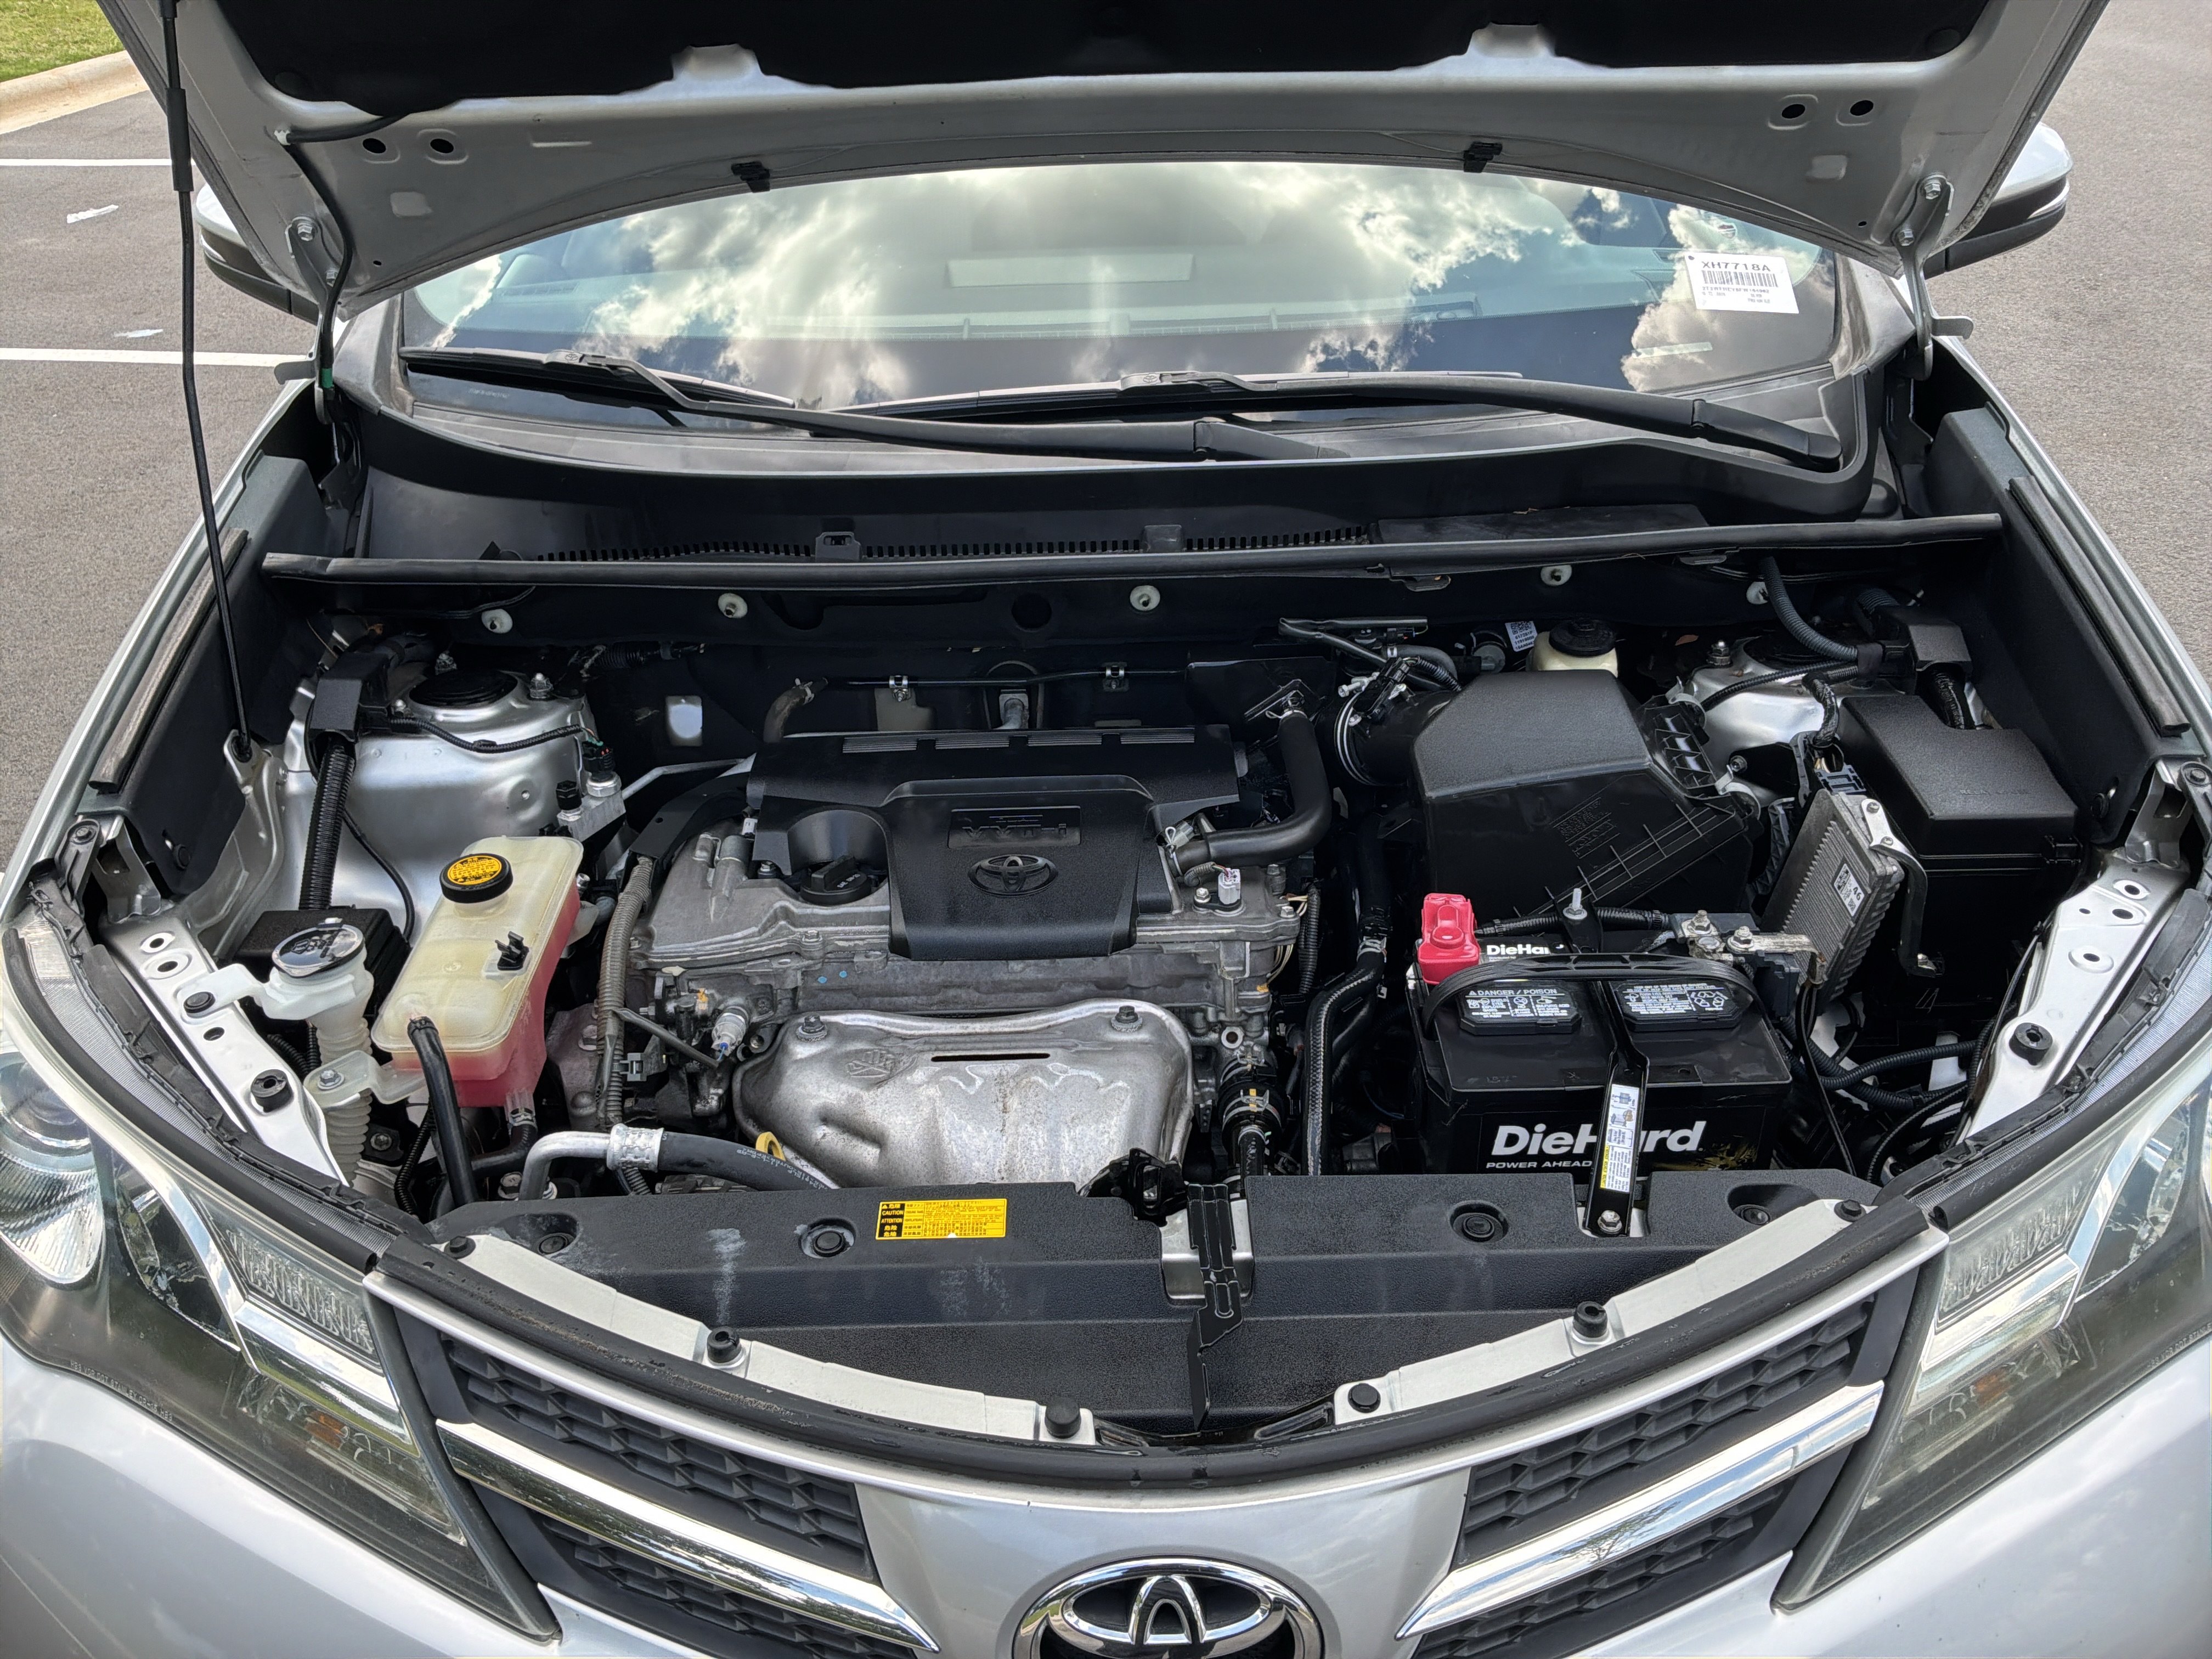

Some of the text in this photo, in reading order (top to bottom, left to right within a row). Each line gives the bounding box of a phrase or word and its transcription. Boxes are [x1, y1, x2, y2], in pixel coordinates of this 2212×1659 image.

[1701, 261, 1771, 272] XH7718A
[1491, 1120, 1707, 1155] DieHrd
[96, 1372, 109, 1383] DOT
[110, 1379, 138, 1400] STANLEY
